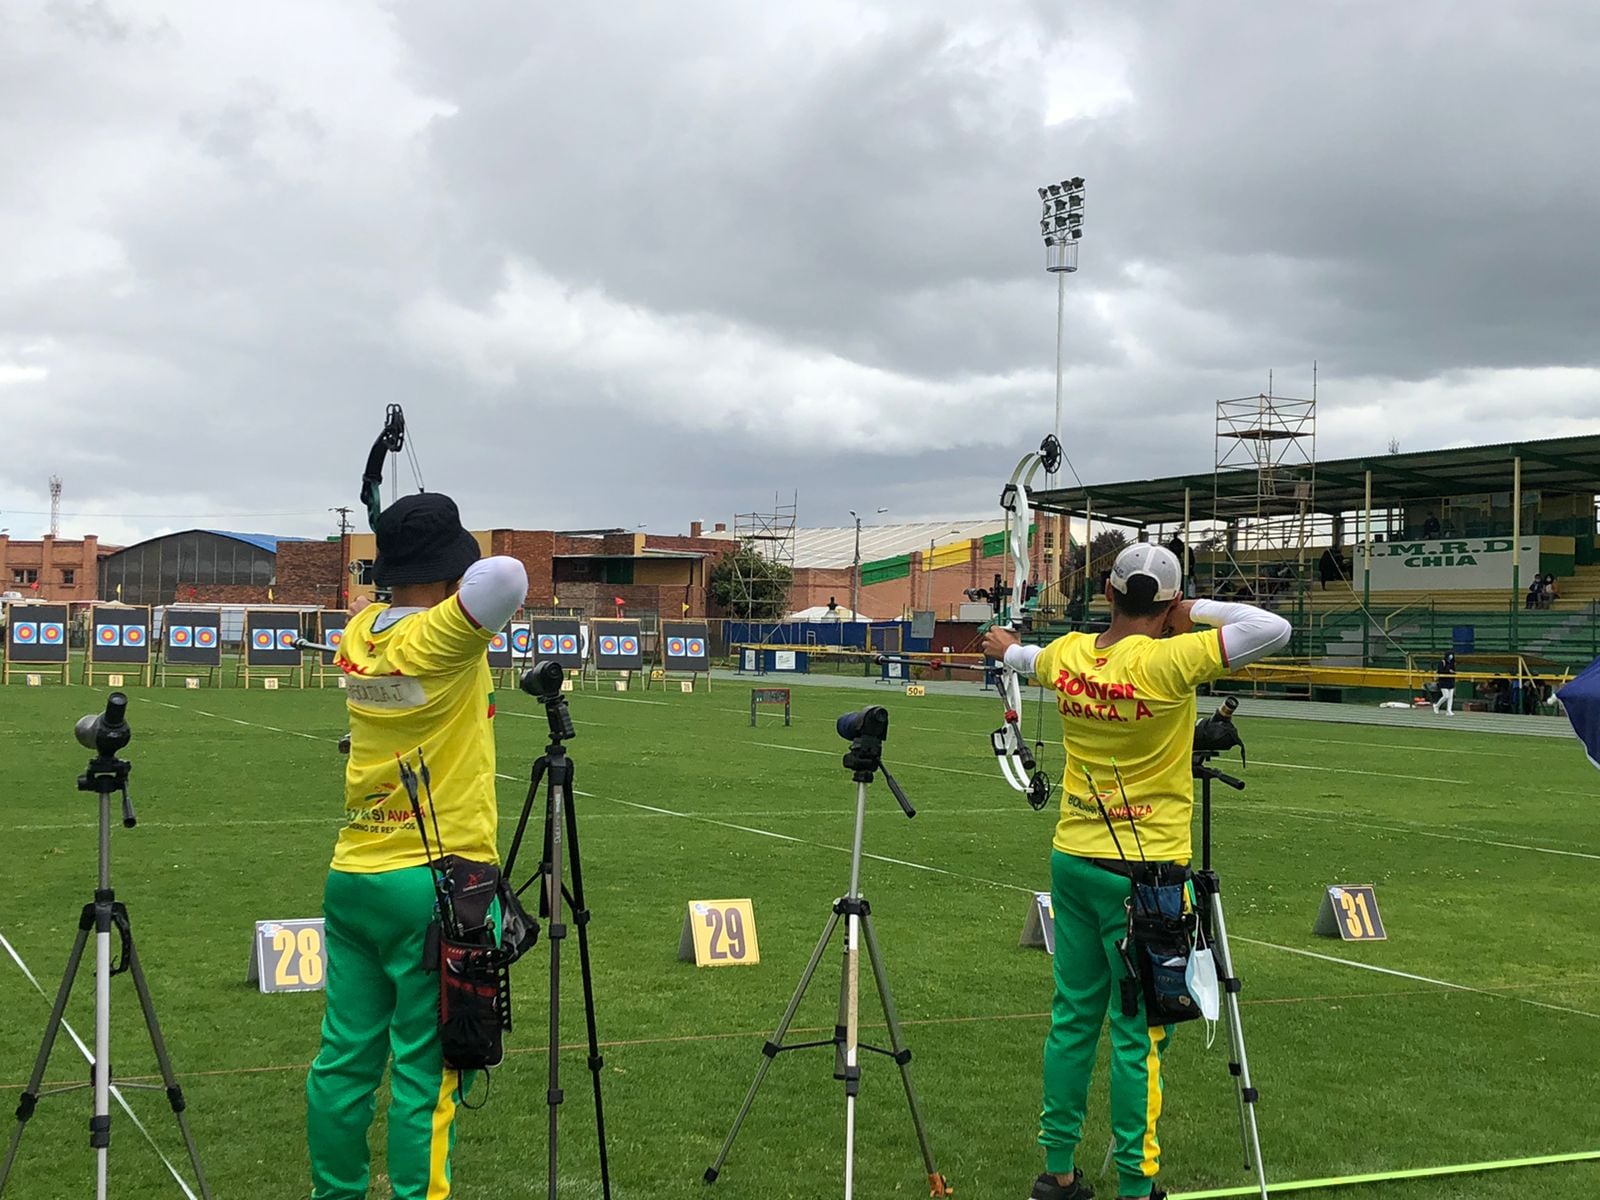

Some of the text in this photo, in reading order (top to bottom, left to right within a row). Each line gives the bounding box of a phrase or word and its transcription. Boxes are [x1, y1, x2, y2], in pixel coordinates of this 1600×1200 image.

[1403, 555, 1478, 568] CHIA
[705, 907, 746, 960] 29
[1340, 892, 1376, 938] 31
[272, 927, 323, 986] 28
